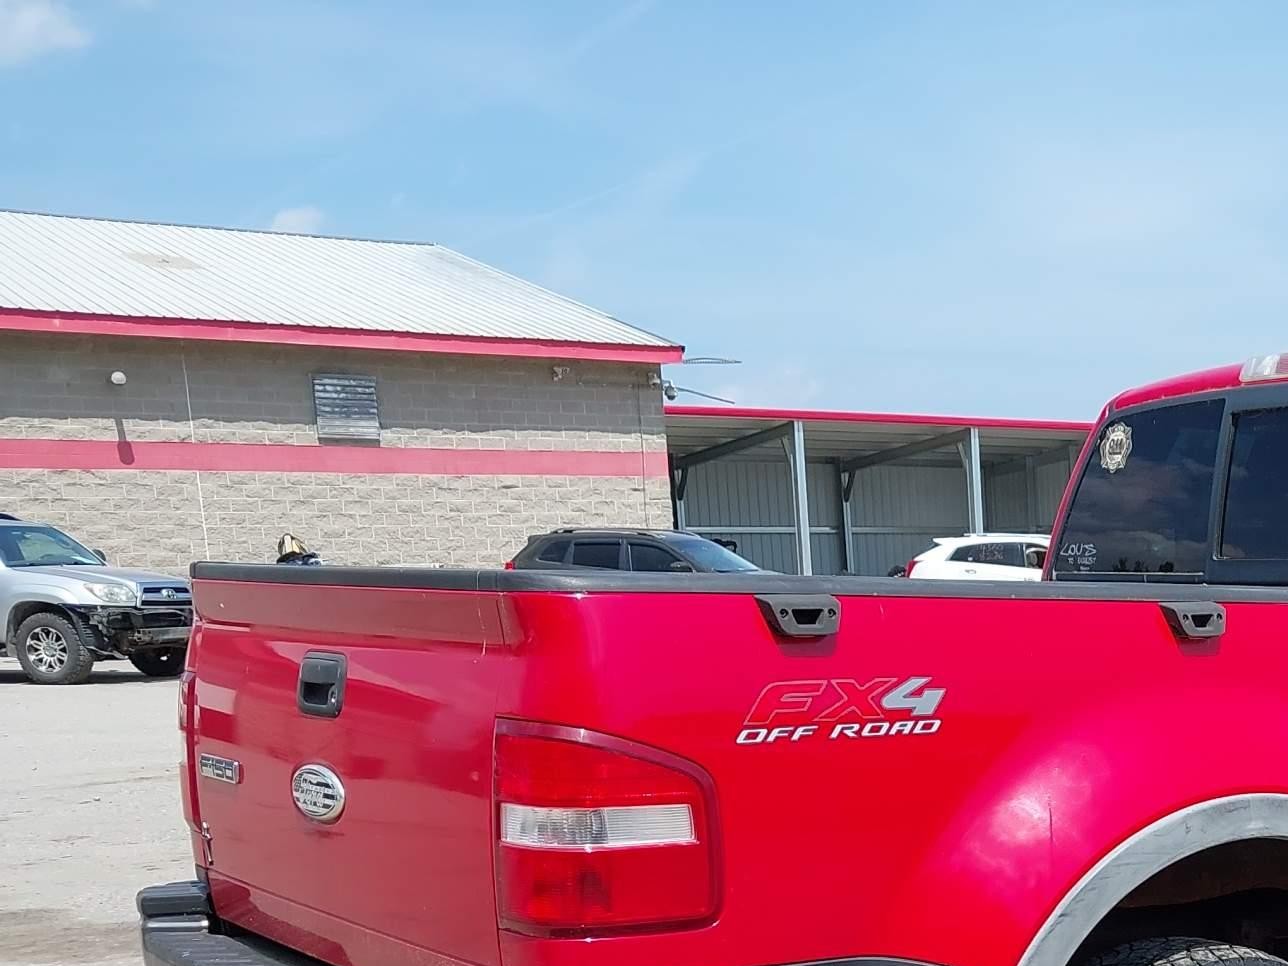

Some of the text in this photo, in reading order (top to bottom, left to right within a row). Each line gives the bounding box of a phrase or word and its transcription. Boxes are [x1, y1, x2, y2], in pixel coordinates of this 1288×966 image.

[743, 676, 947, 726] FX4
[735, 719, 942, 745] OFF ROAD
